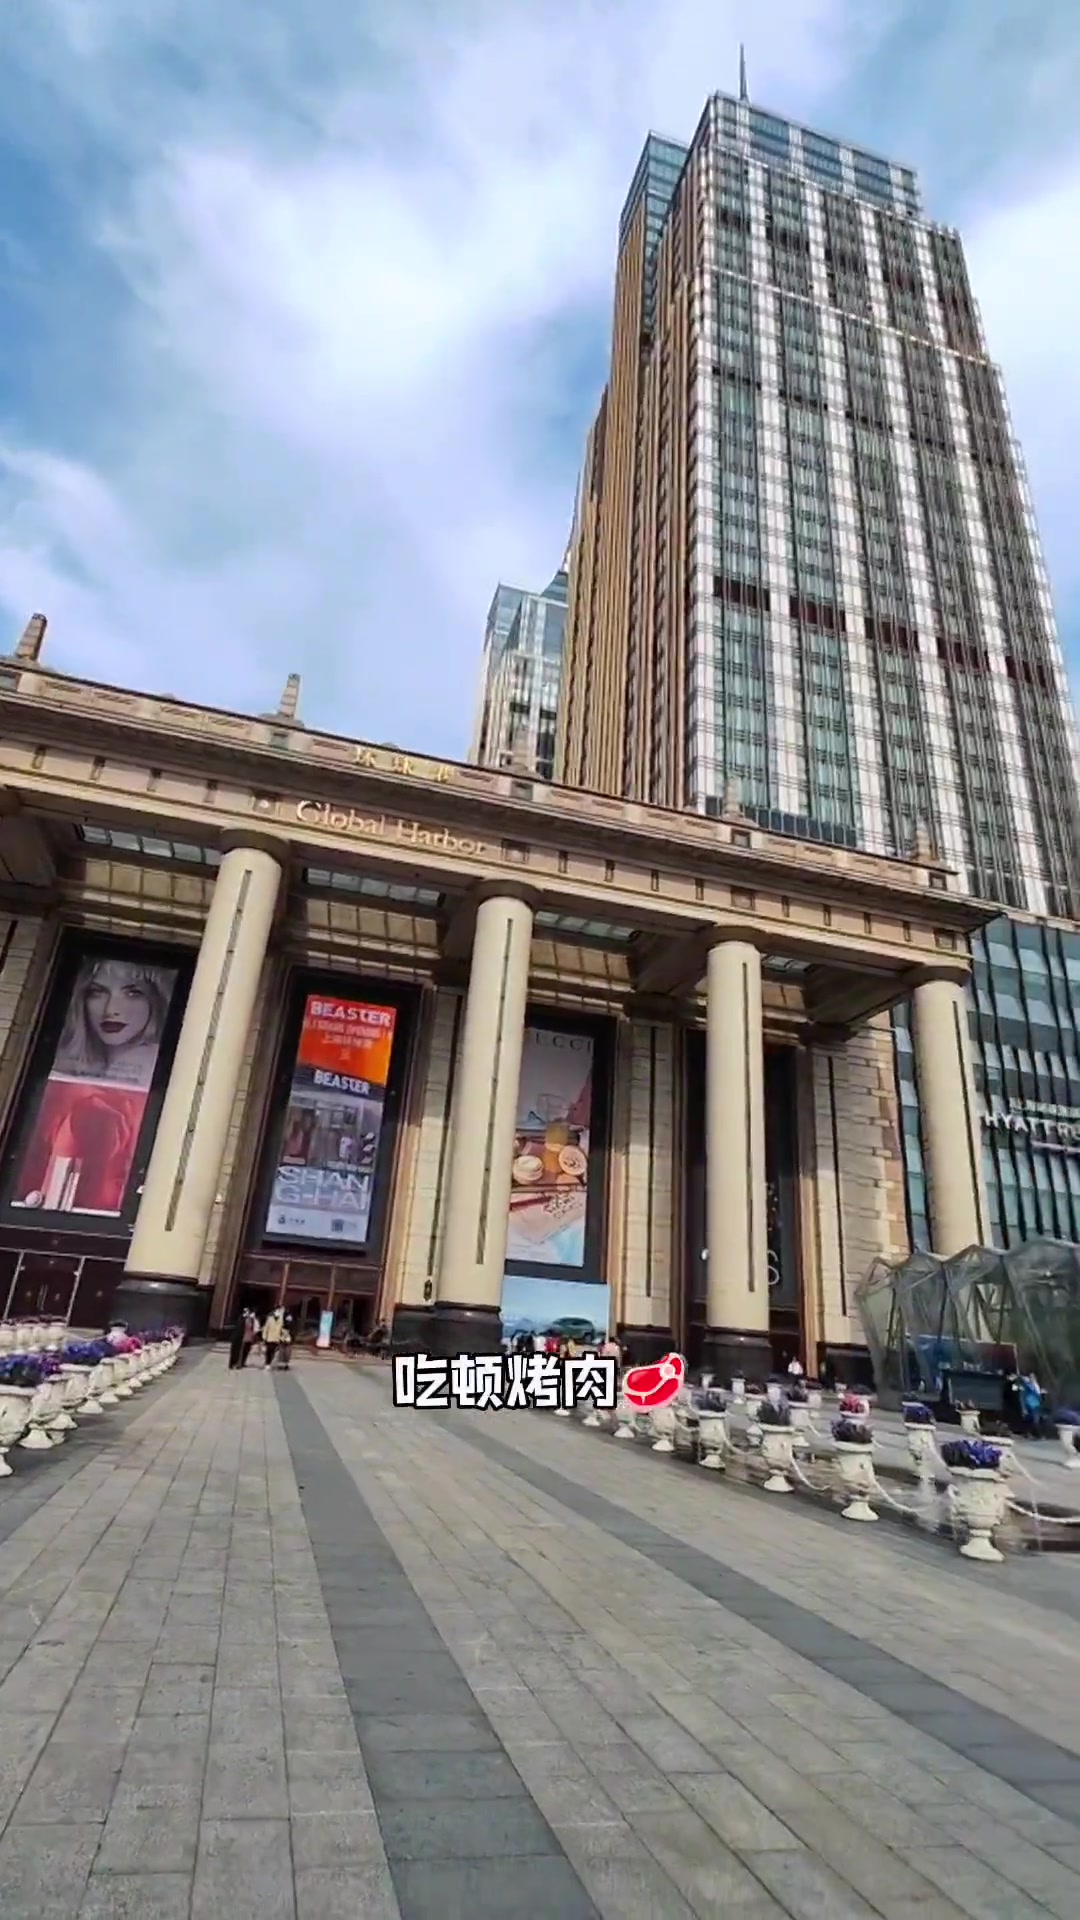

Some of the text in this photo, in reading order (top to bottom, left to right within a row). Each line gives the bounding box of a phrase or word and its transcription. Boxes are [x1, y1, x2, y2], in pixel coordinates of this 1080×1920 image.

[296, 799, 487, 855] Global Harbor
[310, 1001, 391, 1027] BEASTER
[313, 1069, 370, 1096] BEASTER
[985, 1111, 1054, 1136] HYATT
[276, 1166, 369, 1192] SHAN
